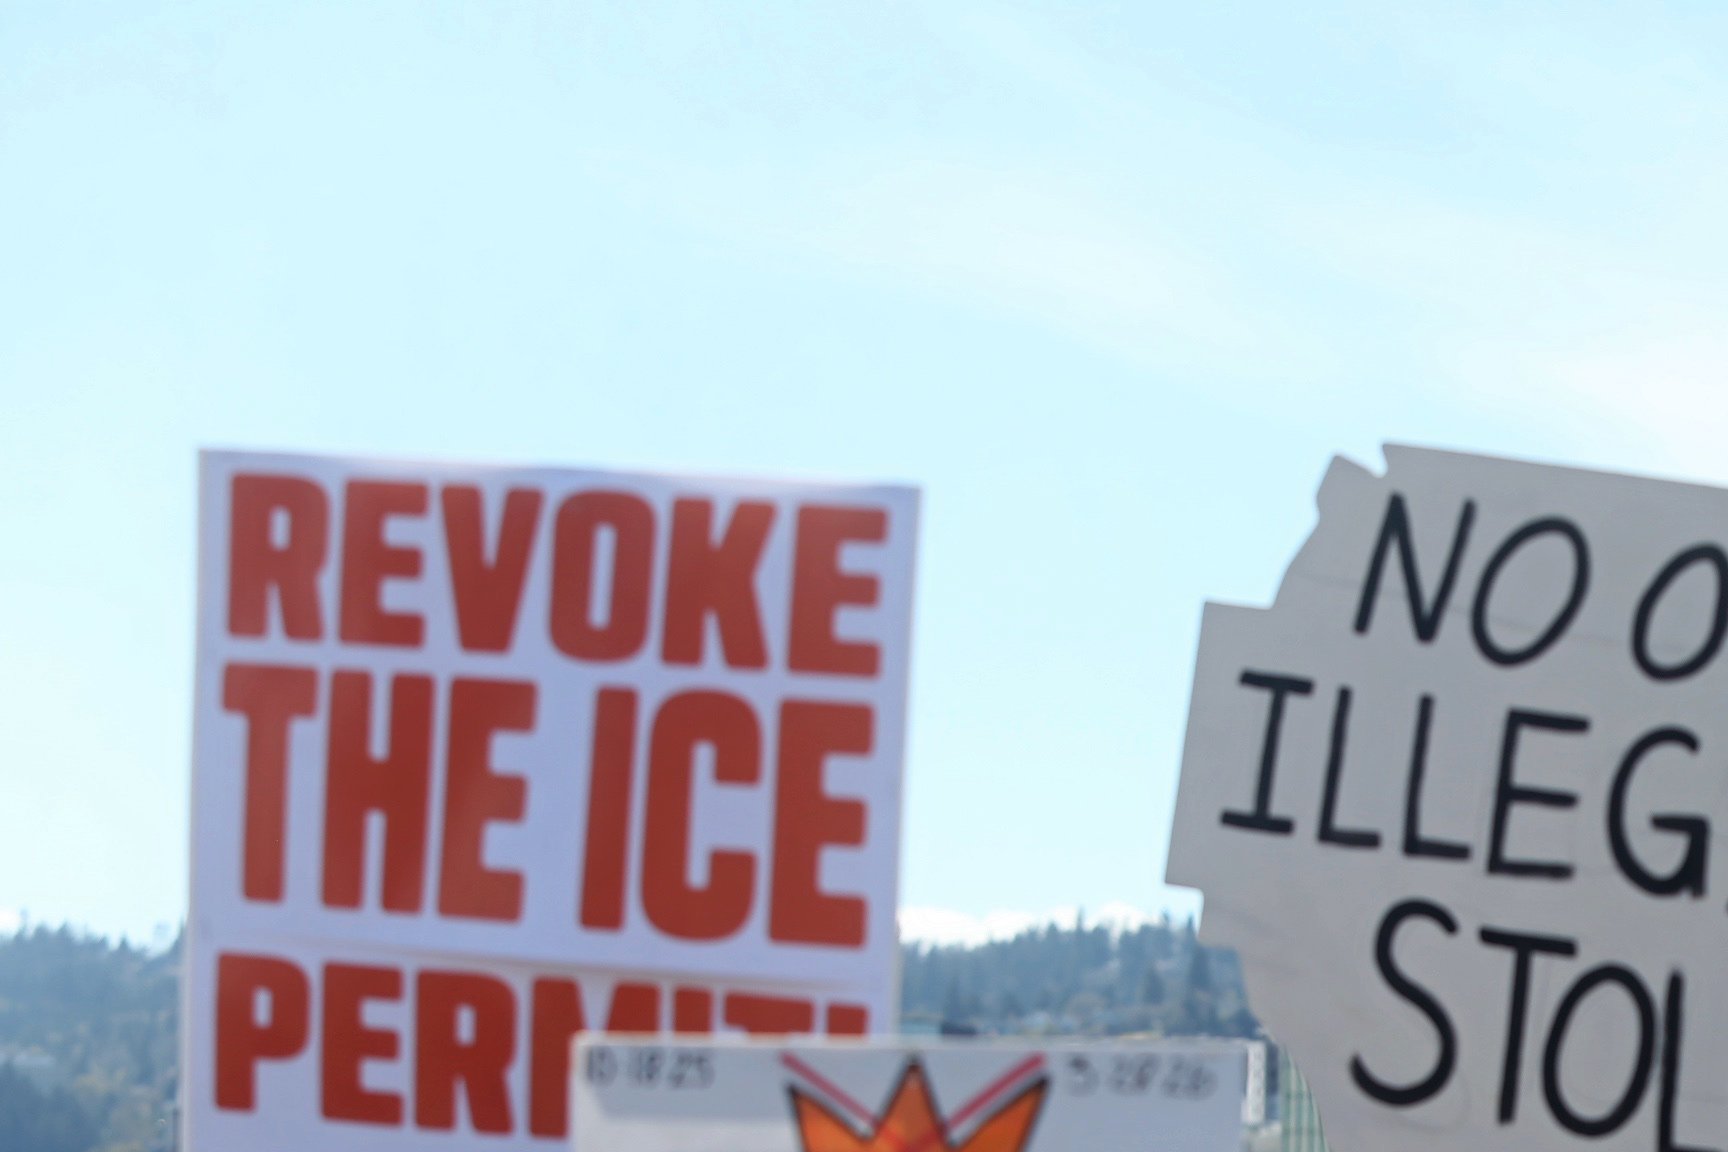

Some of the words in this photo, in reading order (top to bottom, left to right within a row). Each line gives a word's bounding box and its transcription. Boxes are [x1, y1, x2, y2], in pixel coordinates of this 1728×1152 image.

[227, 471, 890, 680] REVOKE
[1352, 490, 1593, 668] NO
[221, 660, 538, 925] THE
[579, 685, 876, 949] ICE
[213, 951, 870, 1140] PERM
